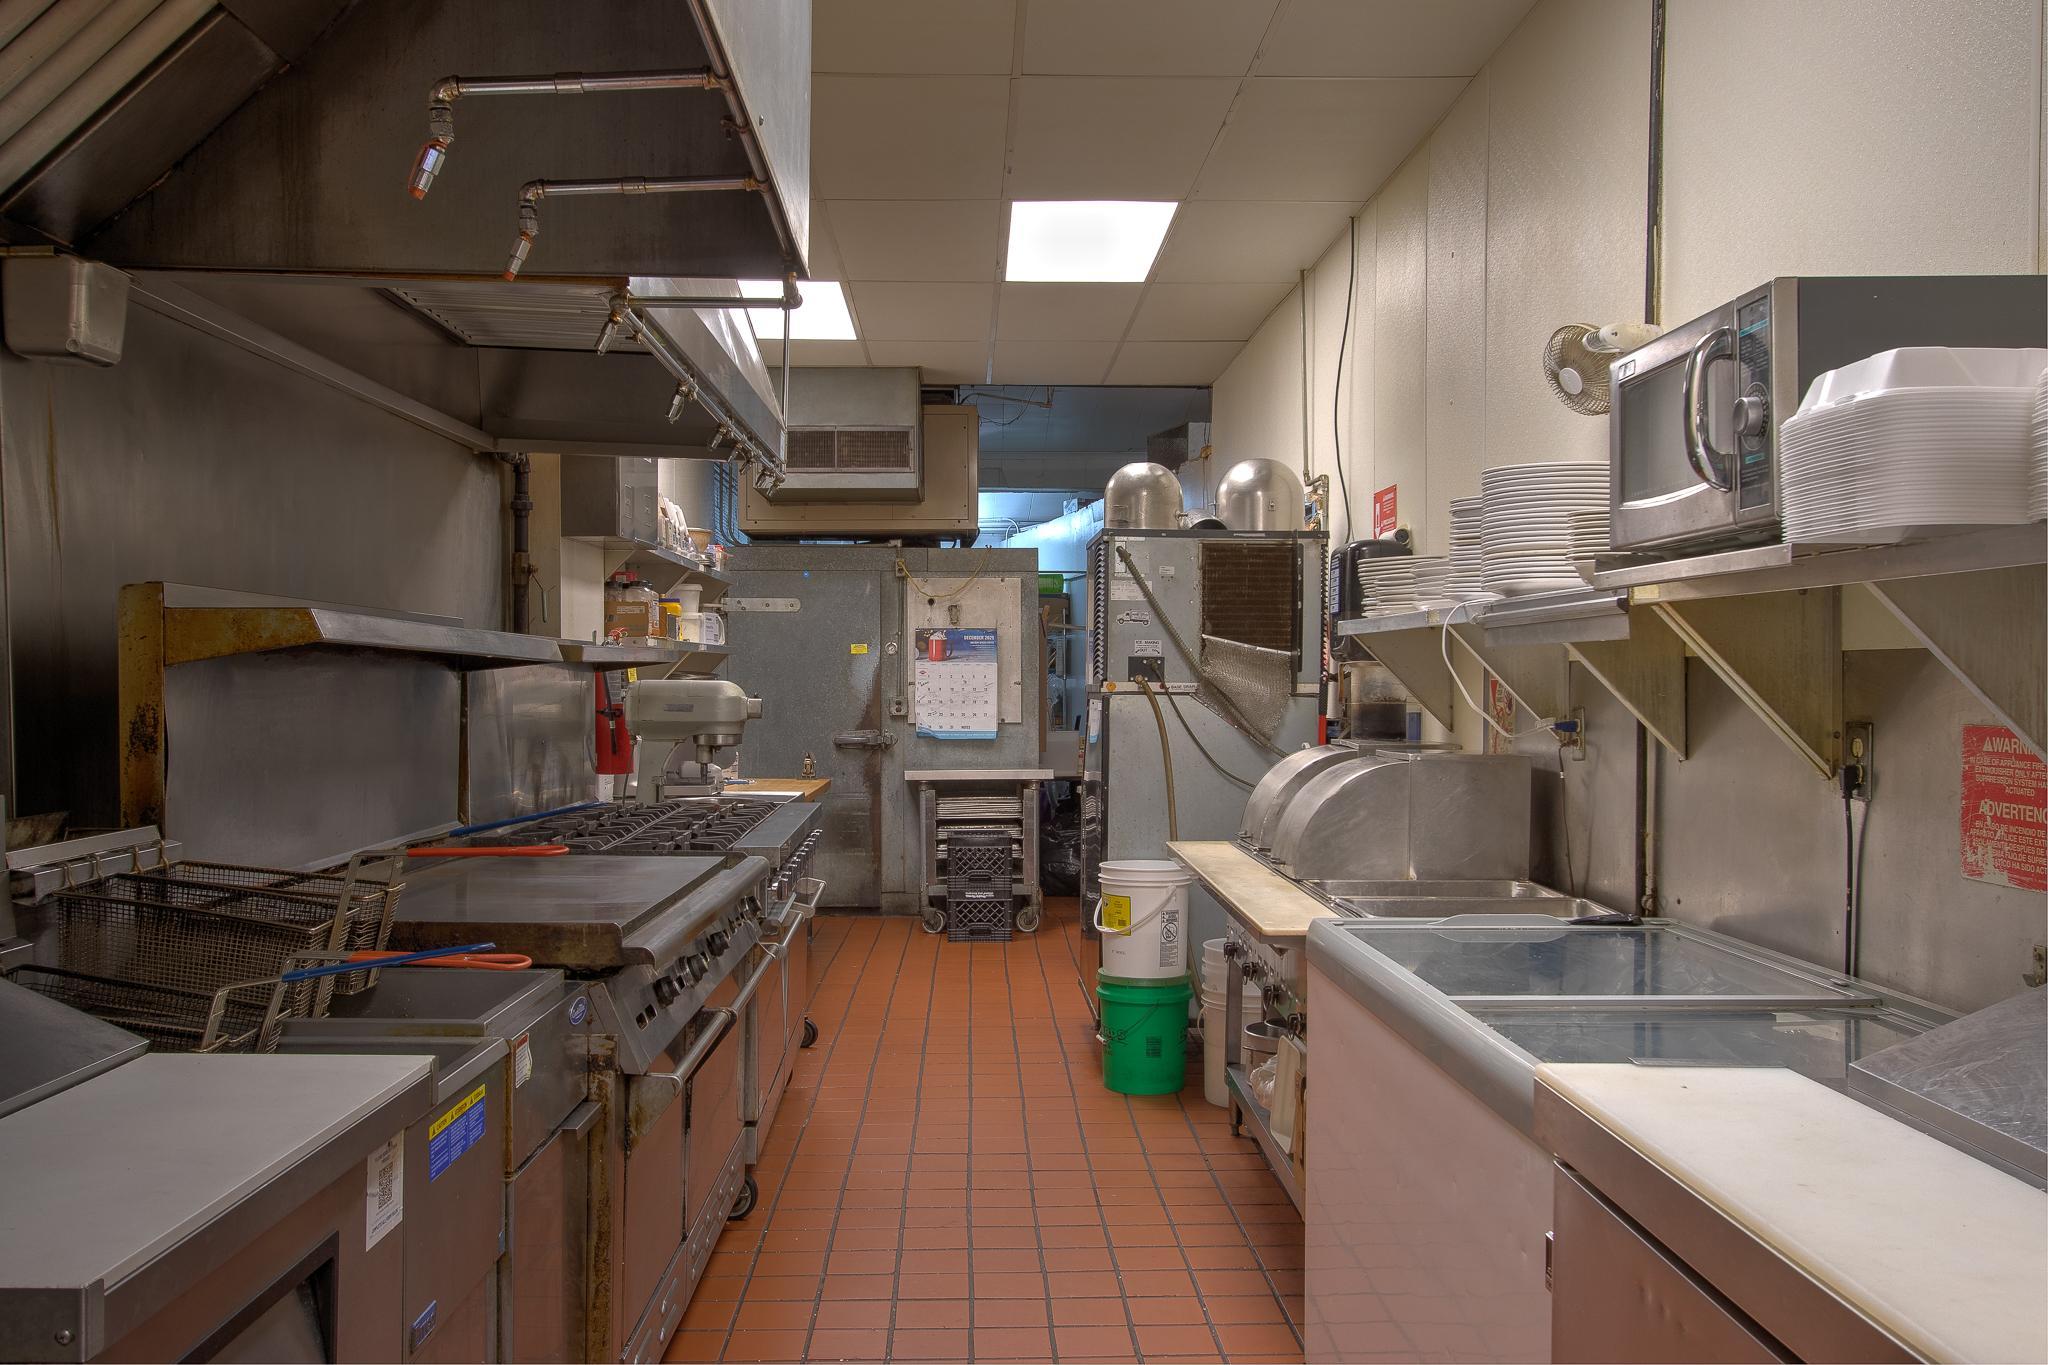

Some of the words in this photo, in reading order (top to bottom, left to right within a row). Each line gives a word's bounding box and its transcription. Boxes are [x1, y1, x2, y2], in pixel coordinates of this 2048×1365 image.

[1992, 736, 2034, 754] WARN
[1976, 766, 2014, 777] EXTINGUISHER
[2014, 769, 2031, 778] ONLY
[2014, 778, 2036, 788] SYSTEM
[2006, 786, 2034, 796] ACTUATED
[2018, 836, 2033, 845] ESTE
[2036, 848, 2045, 856] DE
[2021, 863, 2035, 872] SIDO
